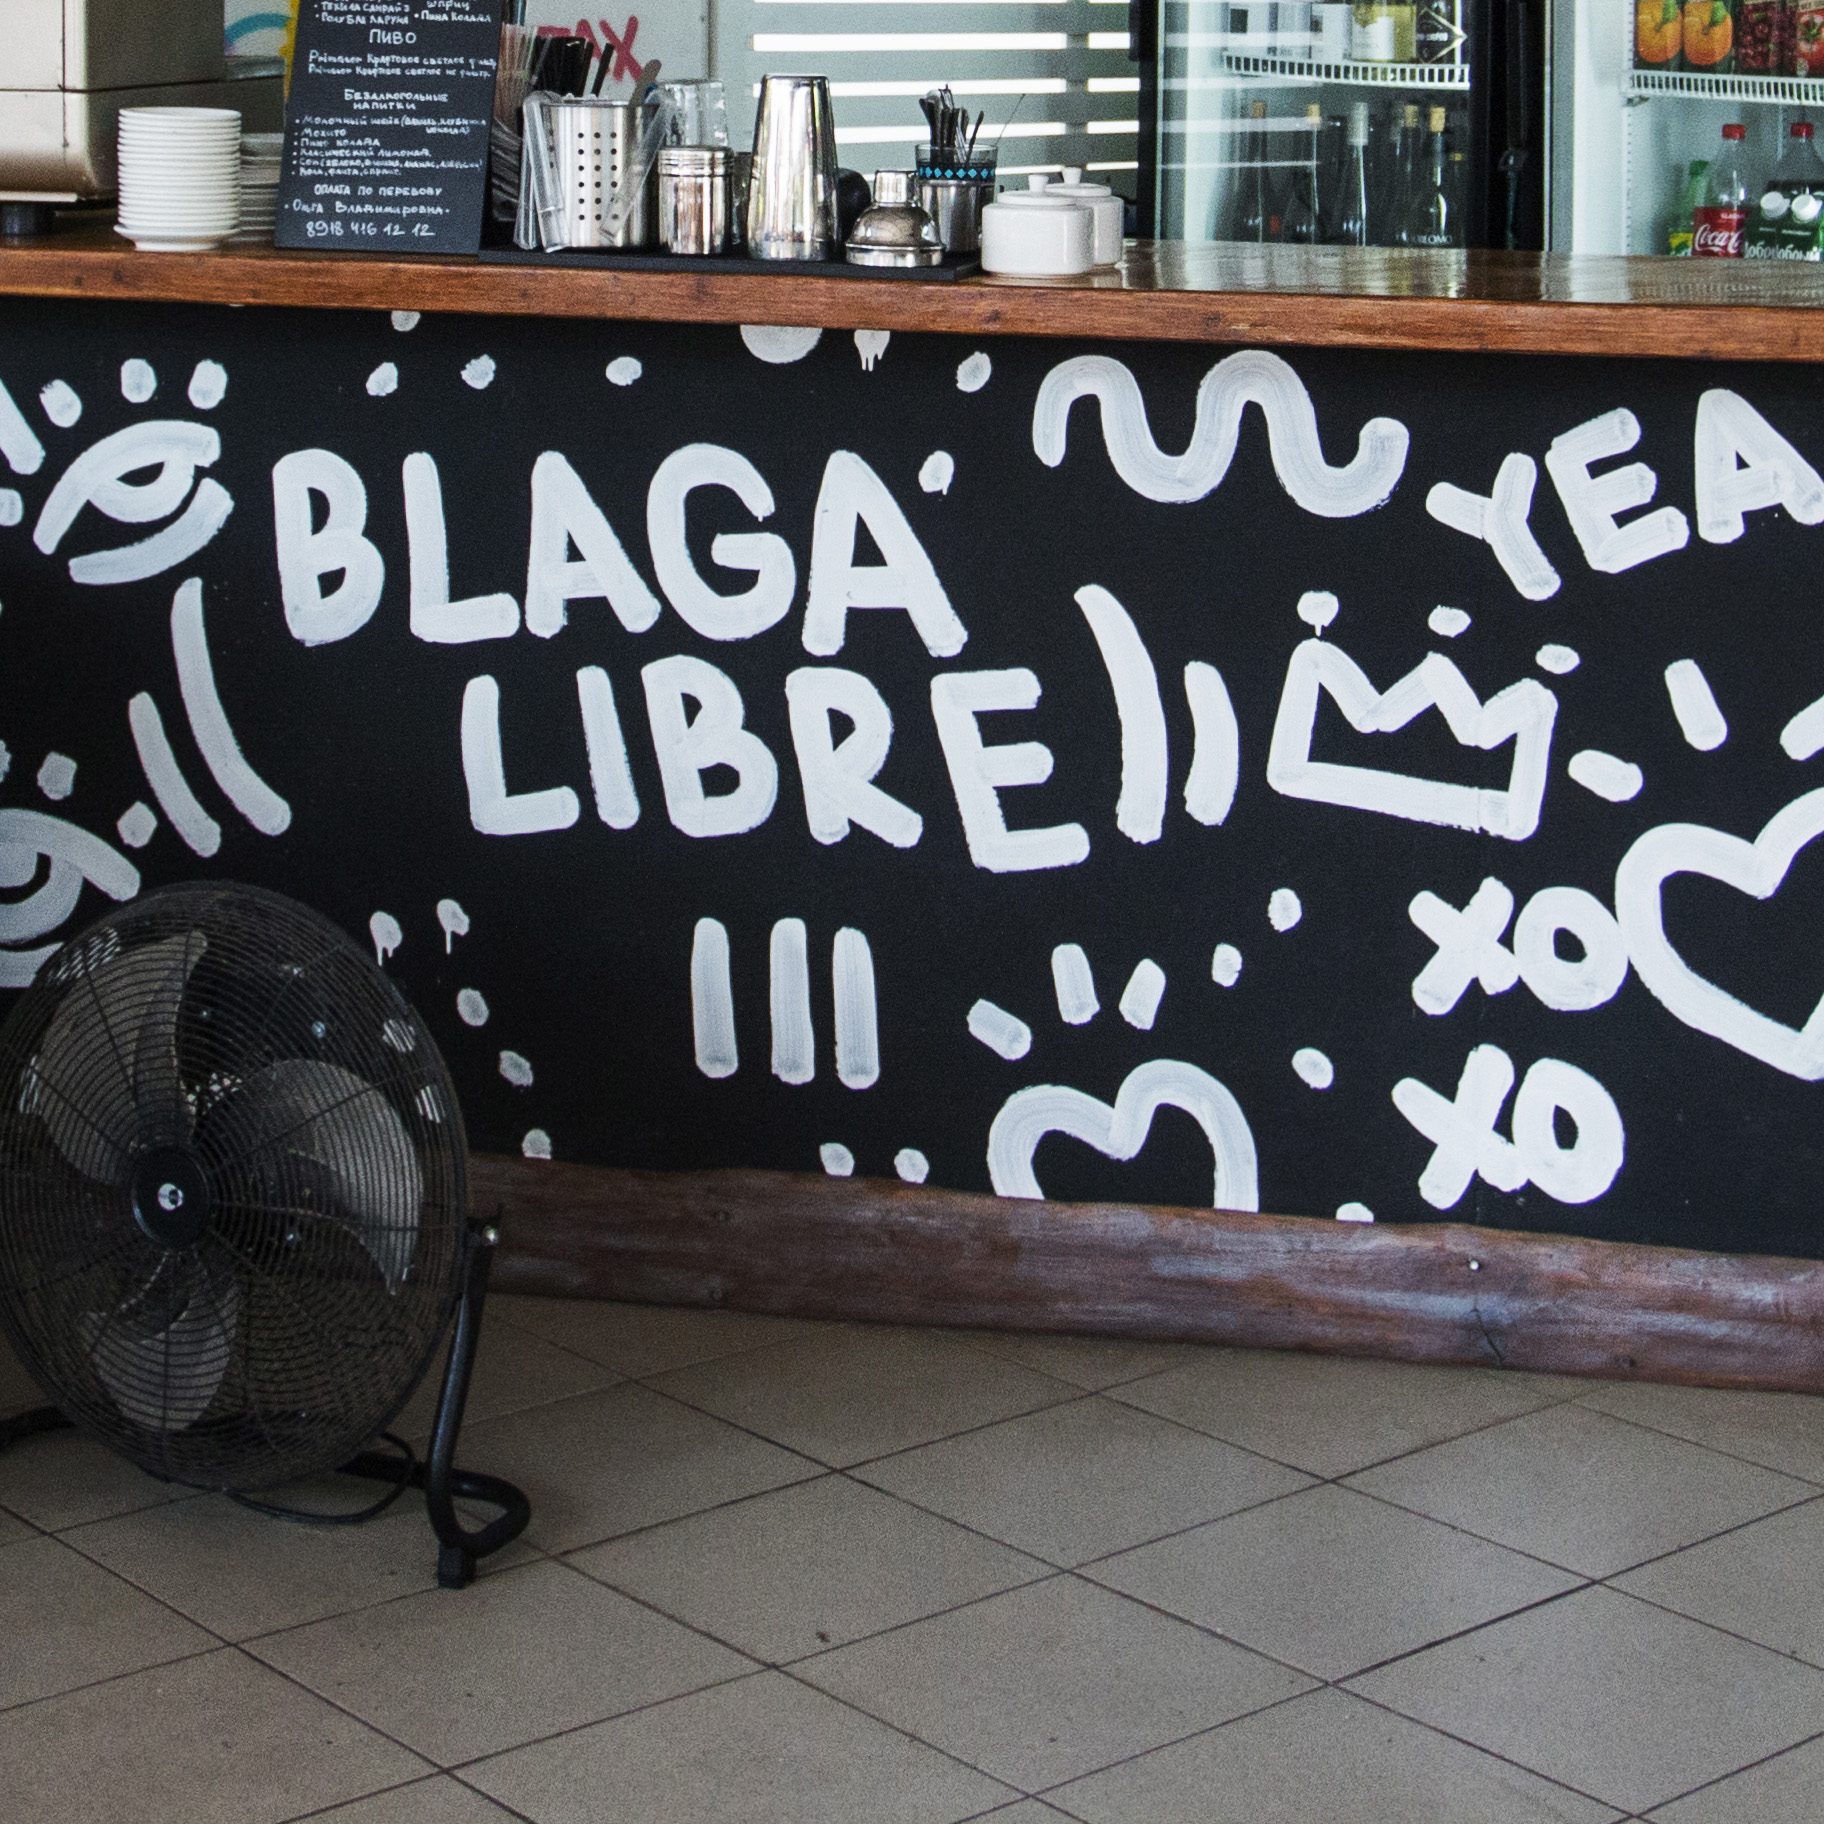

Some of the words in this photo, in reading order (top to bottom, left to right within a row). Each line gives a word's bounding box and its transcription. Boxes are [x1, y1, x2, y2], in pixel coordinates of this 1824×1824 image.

[369, 29, 418, 44] ПИВО
[306, 220, 344, 237] 8918
[350, 222, 376, 236] 416
[383, 222, 406, 236] 12
[412, 223, 437, 237] 12
[272, 443, 969, 658] BLAGA
[461, 654, 1090, 873] LIBRE
